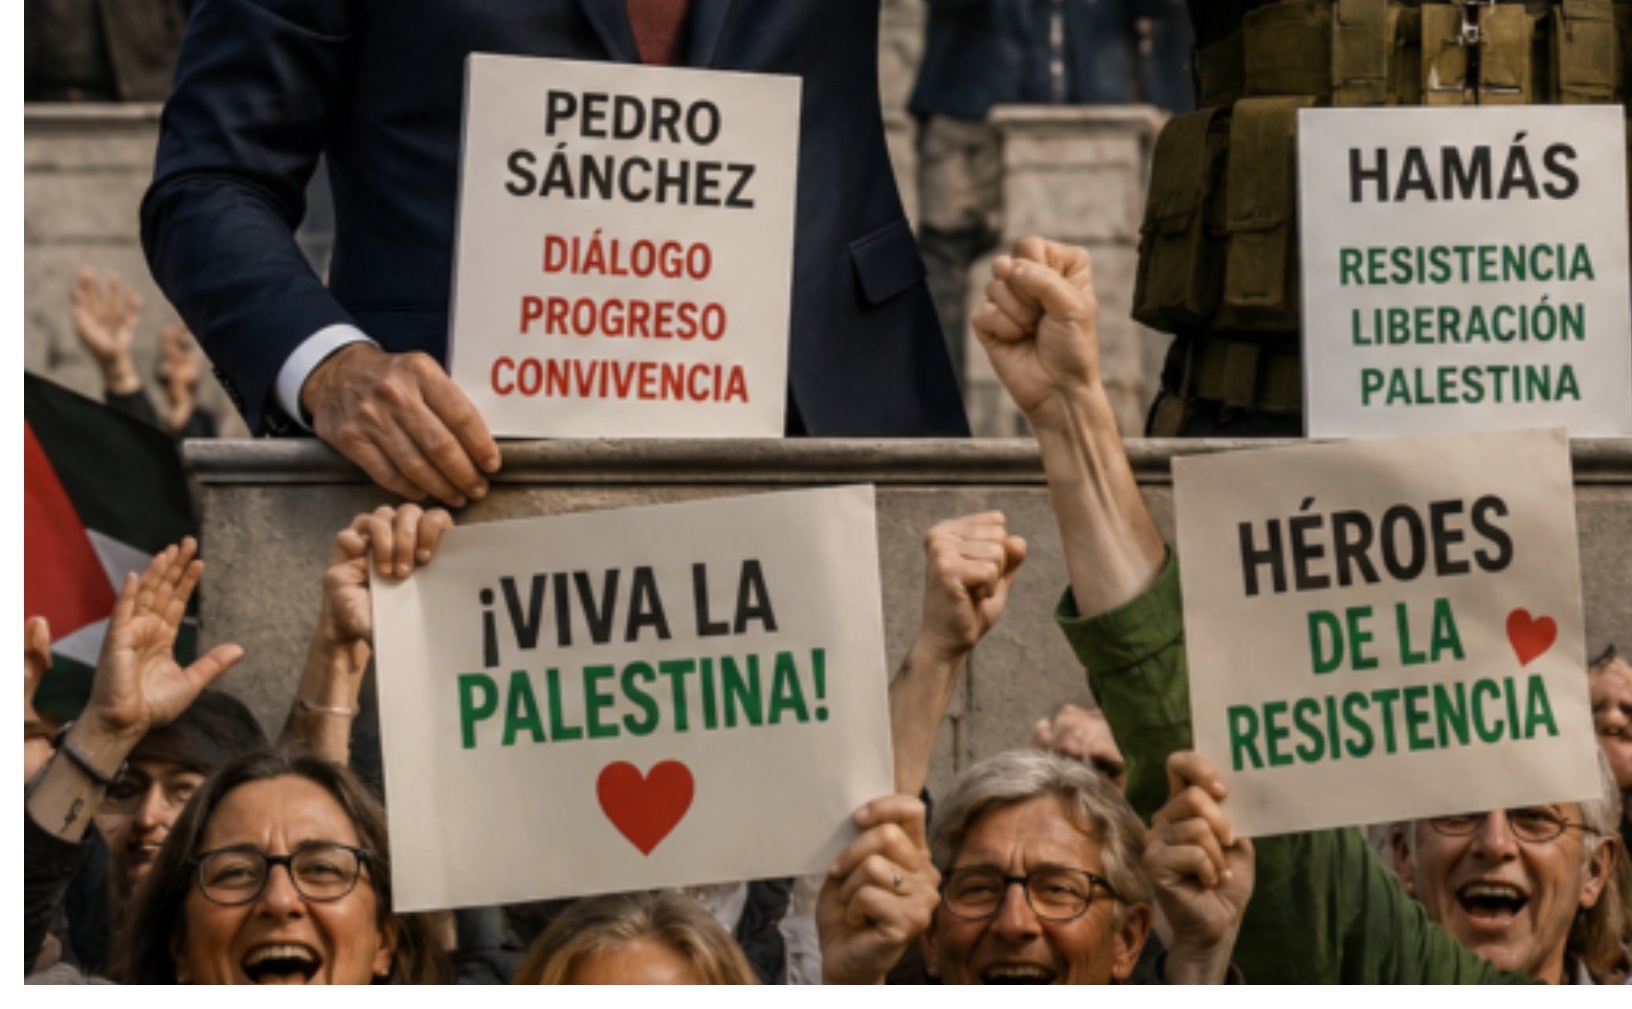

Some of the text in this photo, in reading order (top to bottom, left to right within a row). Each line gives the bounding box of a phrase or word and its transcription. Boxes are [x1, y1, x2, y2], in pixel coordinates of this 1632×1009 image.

[545, 90, 721, 145] PEDRO
[505, 143, 755, 209] SÁNCHEZ
[1349, 132, 1579, 203] HAMÁS
[543, 229, 711, 280] DIÁLOGO
[1340, 244, 1594, 285] RESISTENCIA
[520, 296, 726, 341] PROGRESO
[1352, 295, 1584, 345] LIBERACIÓN
[491, 356, 748, 403] CONVIVENCIA
[1361, 365, 1580, 406] PALESTINA
[1239, 496, 1513, 596] HÉROES
[480, 560, 777, 668] ¡VIVA LA
[1308, 598, 1464, 674] DE LA
[458, 647, 828, 748] PALESTINA!
[1228, 673, 1557, 771] RESISTENCIA
